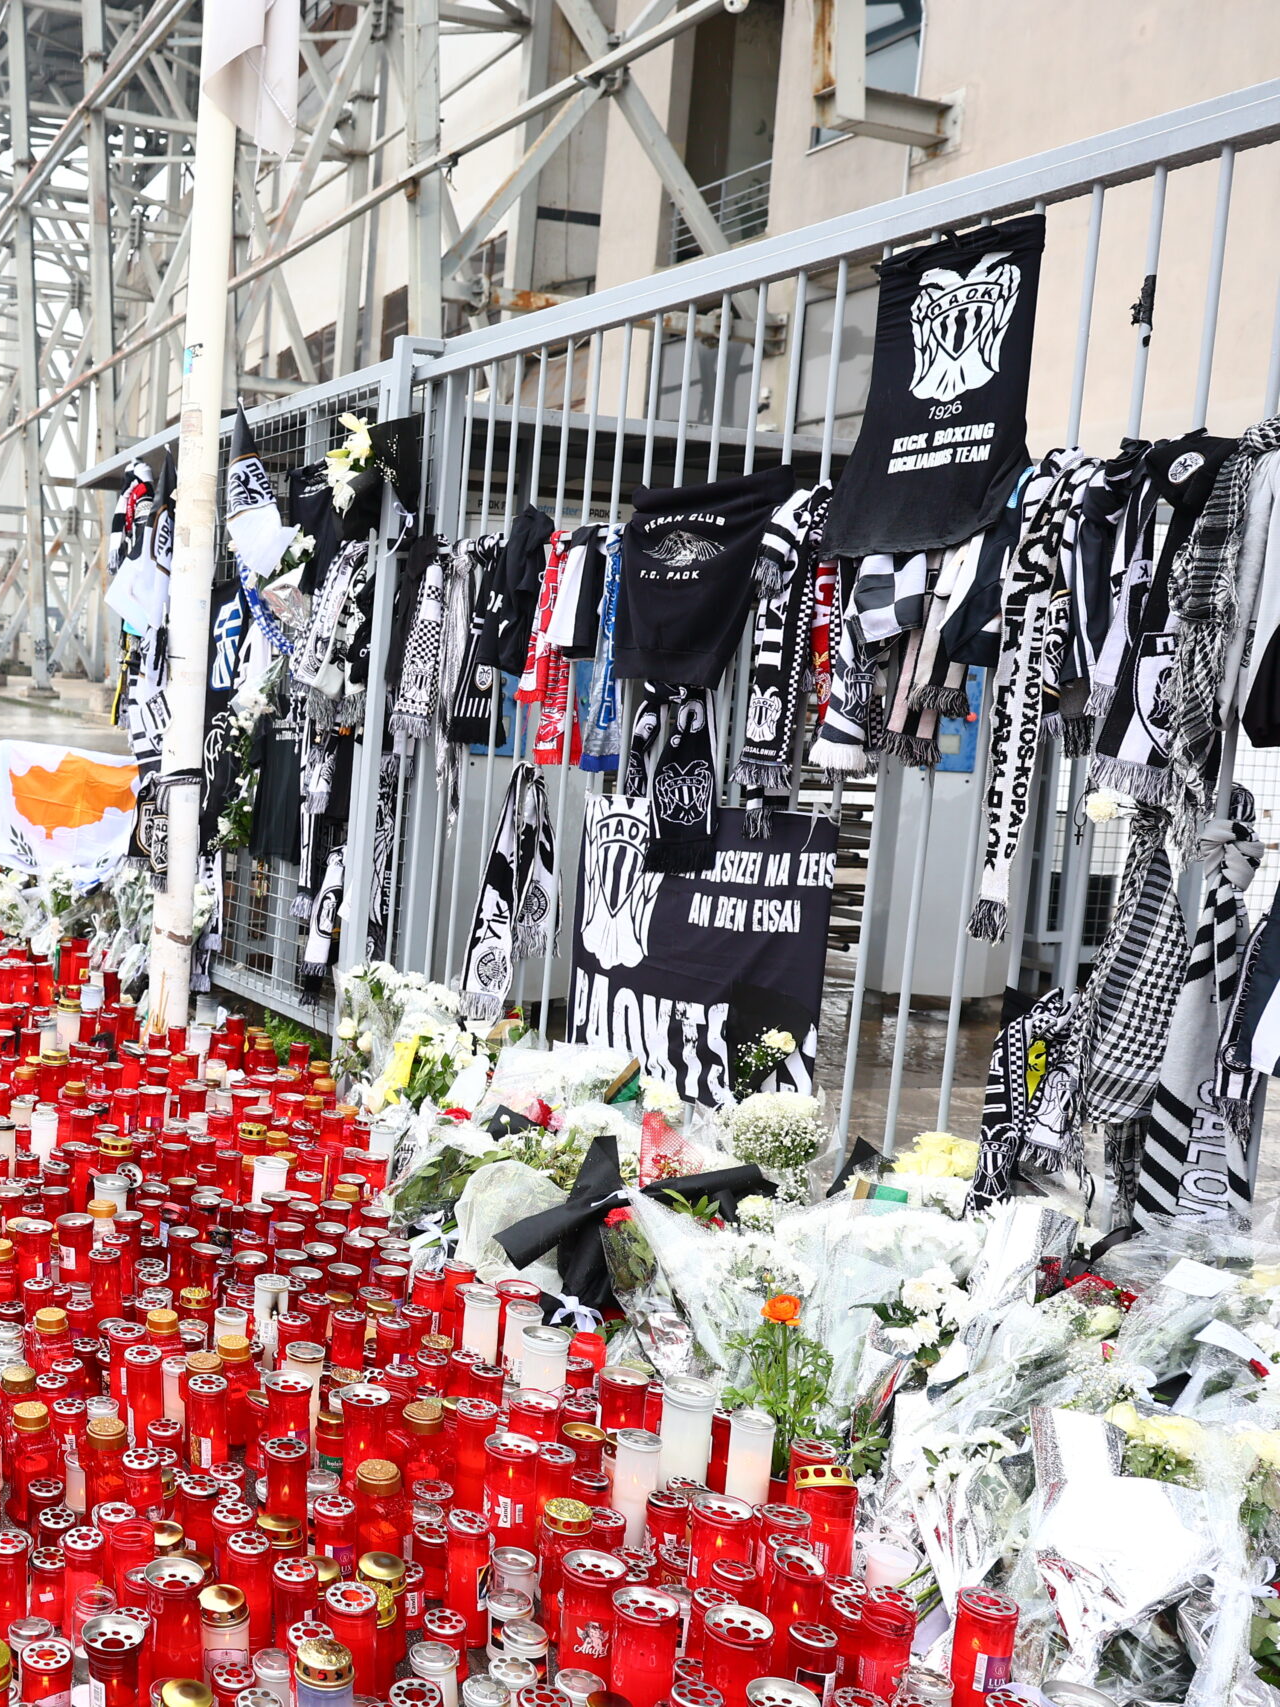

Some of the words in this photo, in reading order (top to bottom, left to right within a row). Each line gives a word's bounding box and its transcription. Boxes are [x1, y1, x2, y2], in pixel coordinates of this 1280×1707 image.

[928, 401, 963, 420] 1926
[892, 433, 929, 454] KICK
[933, 422, 995, 447] BOXING
[955, 444, 991, 463] TEAM
[689, 513, 726, 526] CLUB
[666, 570, 700, 580] PAOK
[764, 852, 791, 887] NA
[797, 852, 837, 890] ZEIS
[688, 892, 713, 928] AN
[713, 895, 748, 932] DEN
[752, 899, 801, 933] EISAI
[574, 1638, 609, 1659] Angel
